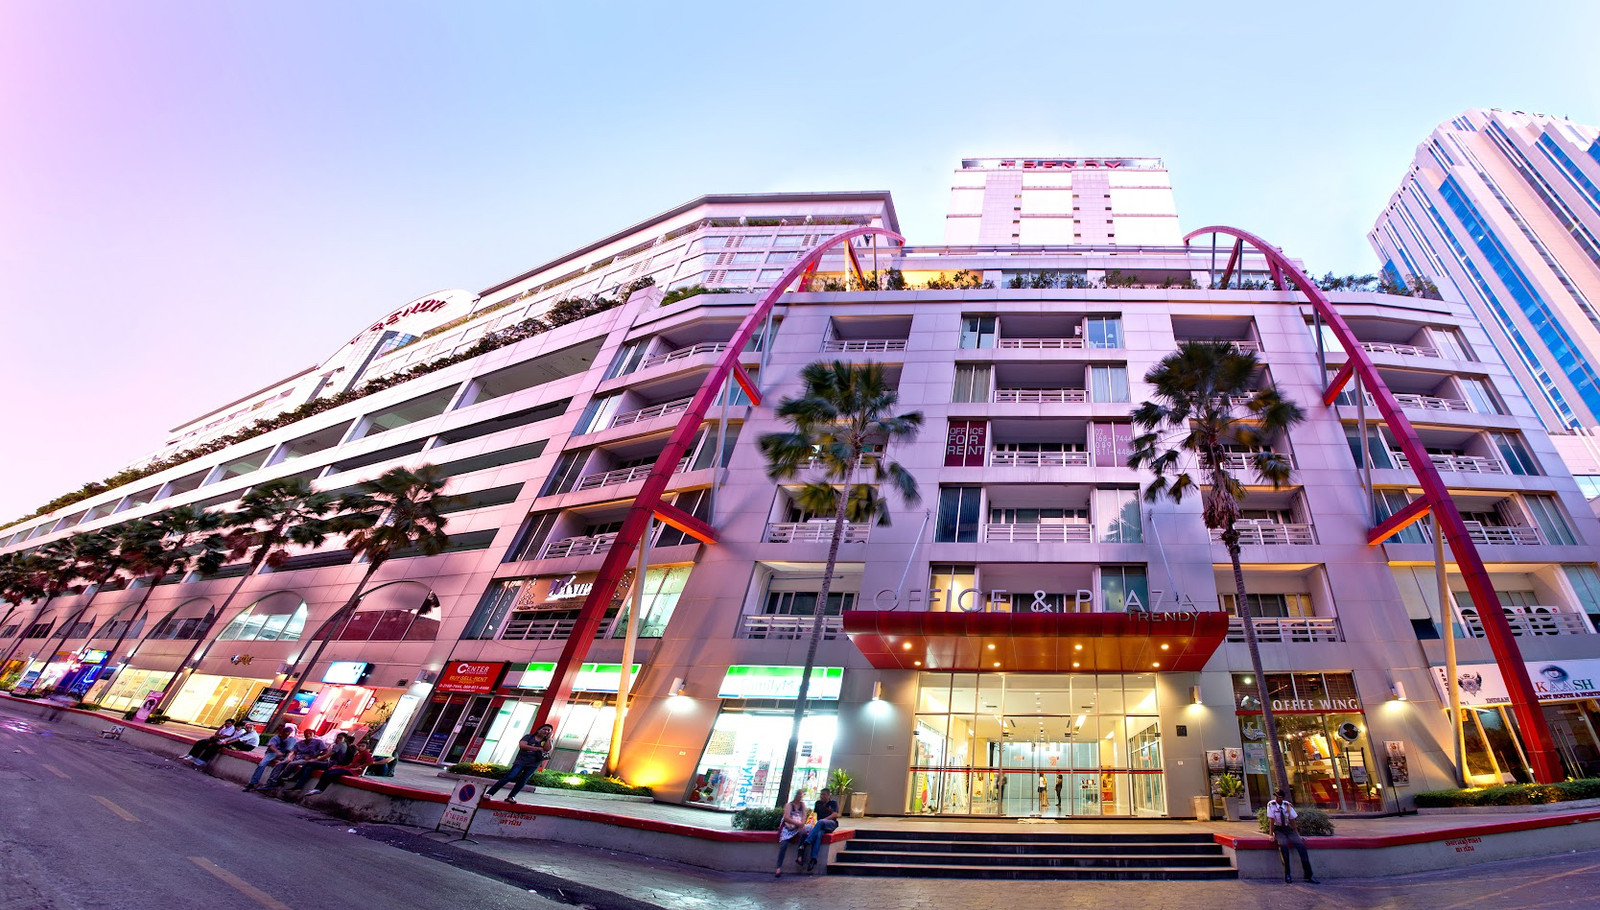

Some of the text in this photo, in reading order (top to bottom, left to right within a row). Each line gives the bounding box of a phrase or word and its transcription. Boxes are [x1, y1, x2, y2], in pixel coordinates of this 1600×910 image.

[948, 435, 978, 444] FOR
[947, 445, 985, 455] RENT
[872, 588, 1199, 613] OFFICE & PLAZA
[1126, 611, 1201, 622] TRENDY
[457, 663, 490, 674] CENTER
[1534, 678, 1595, 692] KAASH
[1273, 698, 1358, 711] OFFEE WING
